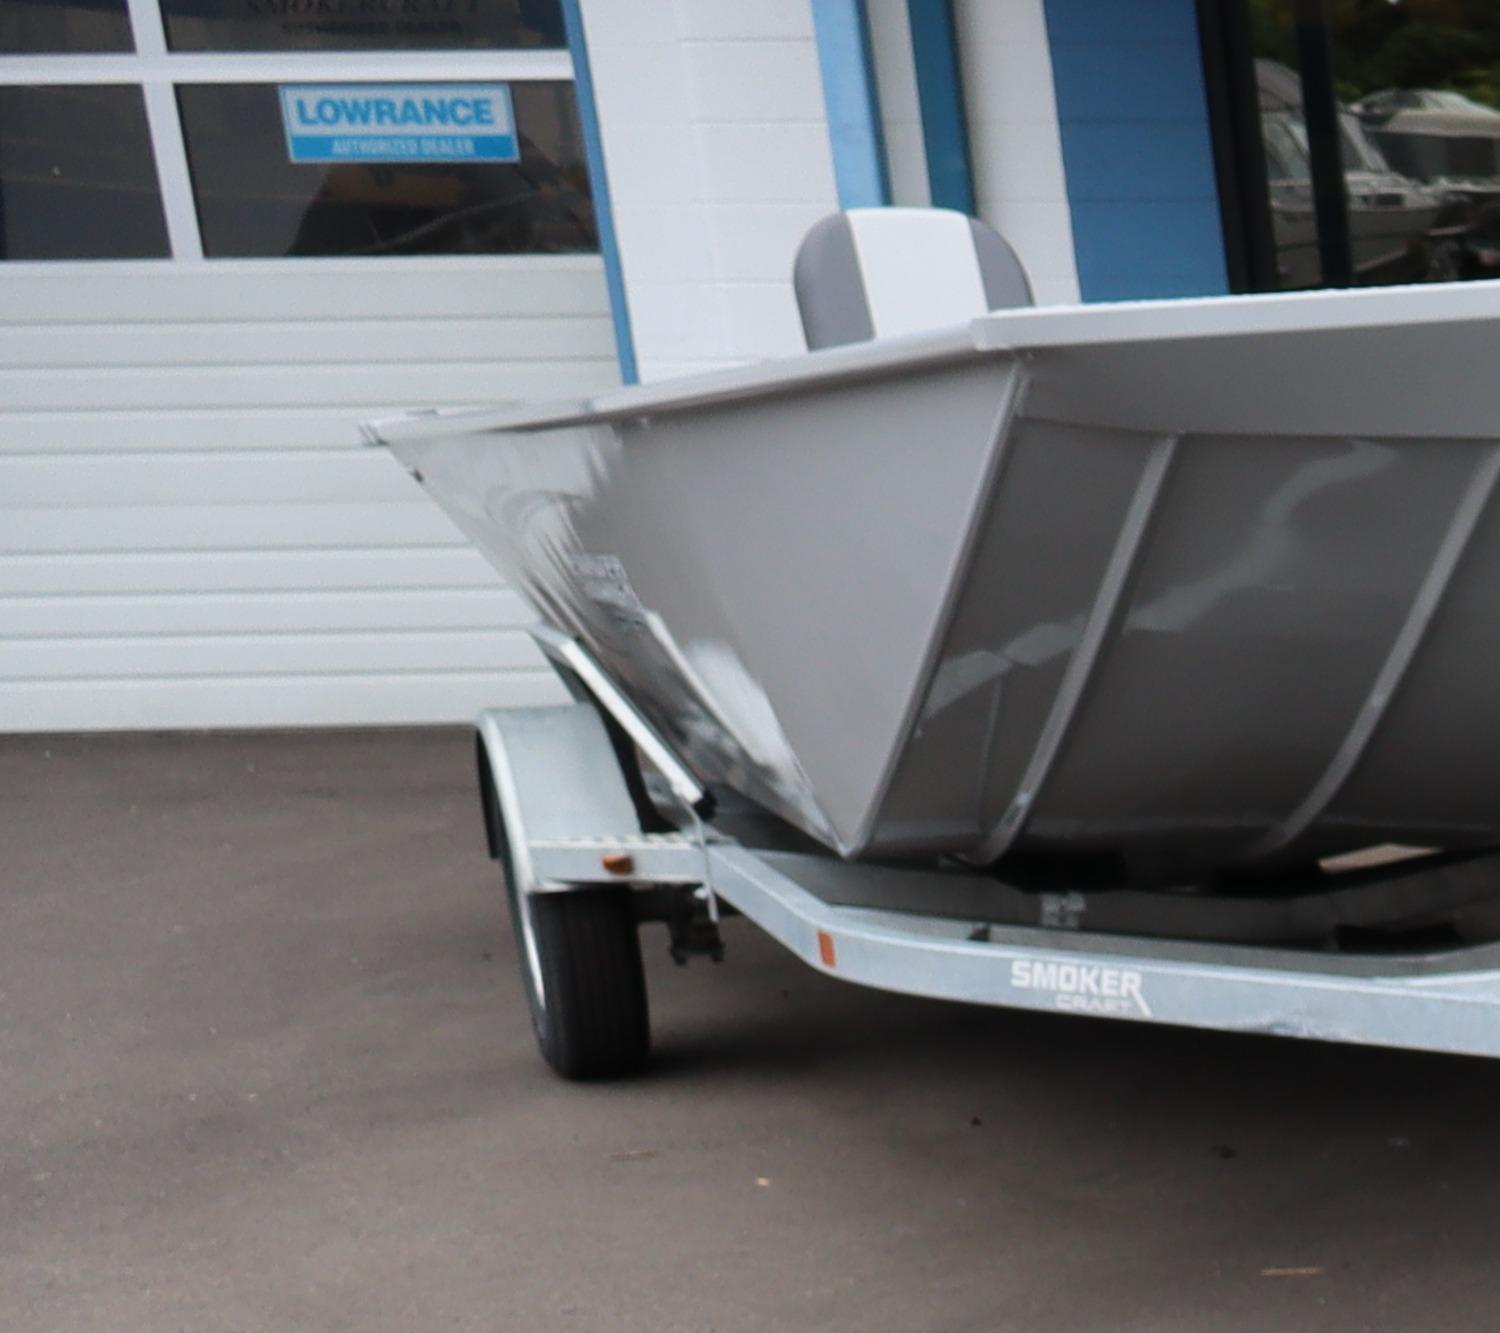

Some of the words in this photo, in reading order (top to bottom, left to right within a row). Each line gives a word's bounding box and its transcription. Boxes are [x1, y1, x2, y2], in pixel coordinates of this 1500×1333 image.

[296, 97, 495, 126] LOWRANCE
[1011, 960, 1153, 1018] SMOKER
[1055, 993, 1132, 1013] CRAFT
